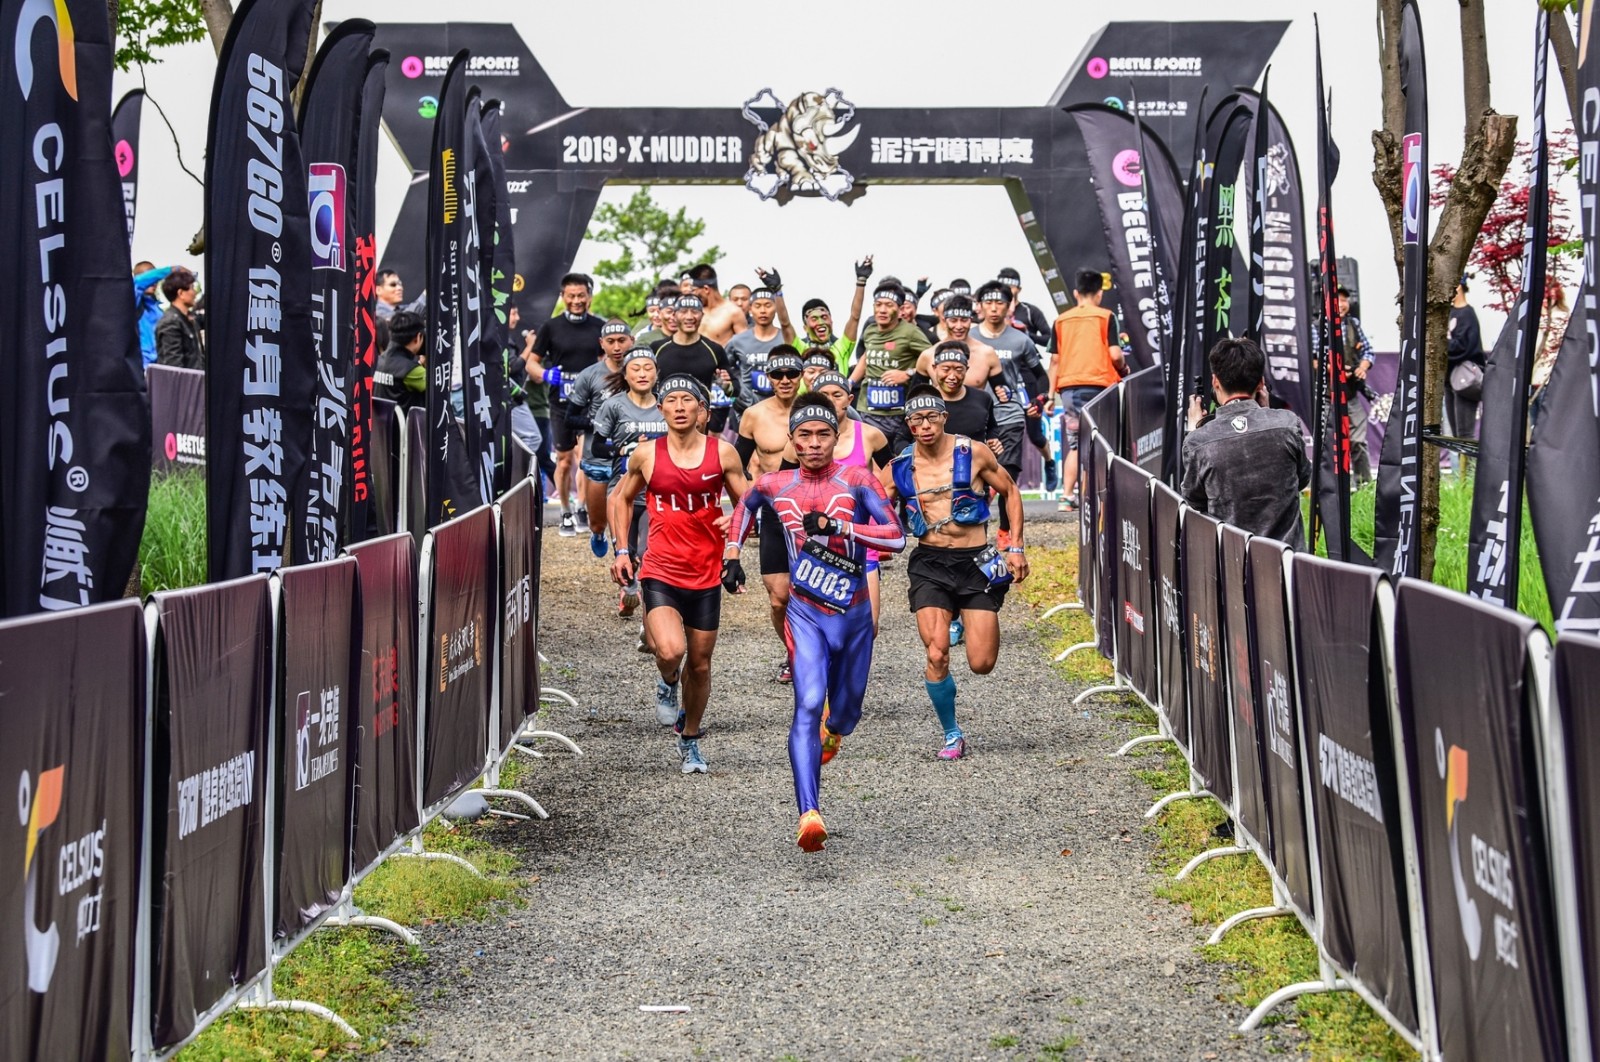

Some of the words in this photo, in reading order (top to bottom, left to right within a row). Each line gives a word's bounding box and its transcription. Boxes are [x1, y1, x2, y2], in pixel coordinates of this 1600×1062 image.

[470, 57, 519, 70] SPORTS
[1110, 58, 1151, 70] BEETLE
[1153, 58, 1202, 70] SPORTS
[871, 137, 1033, 163] 泥泞障碍赛
[605, 324, 625, 333] 0007
[772, 357, 796, 368] 0002
[939, 352, 961, 361] 0104
[871, 390, 899, 404] 0109
[911, 397, 936, 408] 0001
[176, 433, 205, 456] BEETLE
[795, 559, 851, 601] 0003
